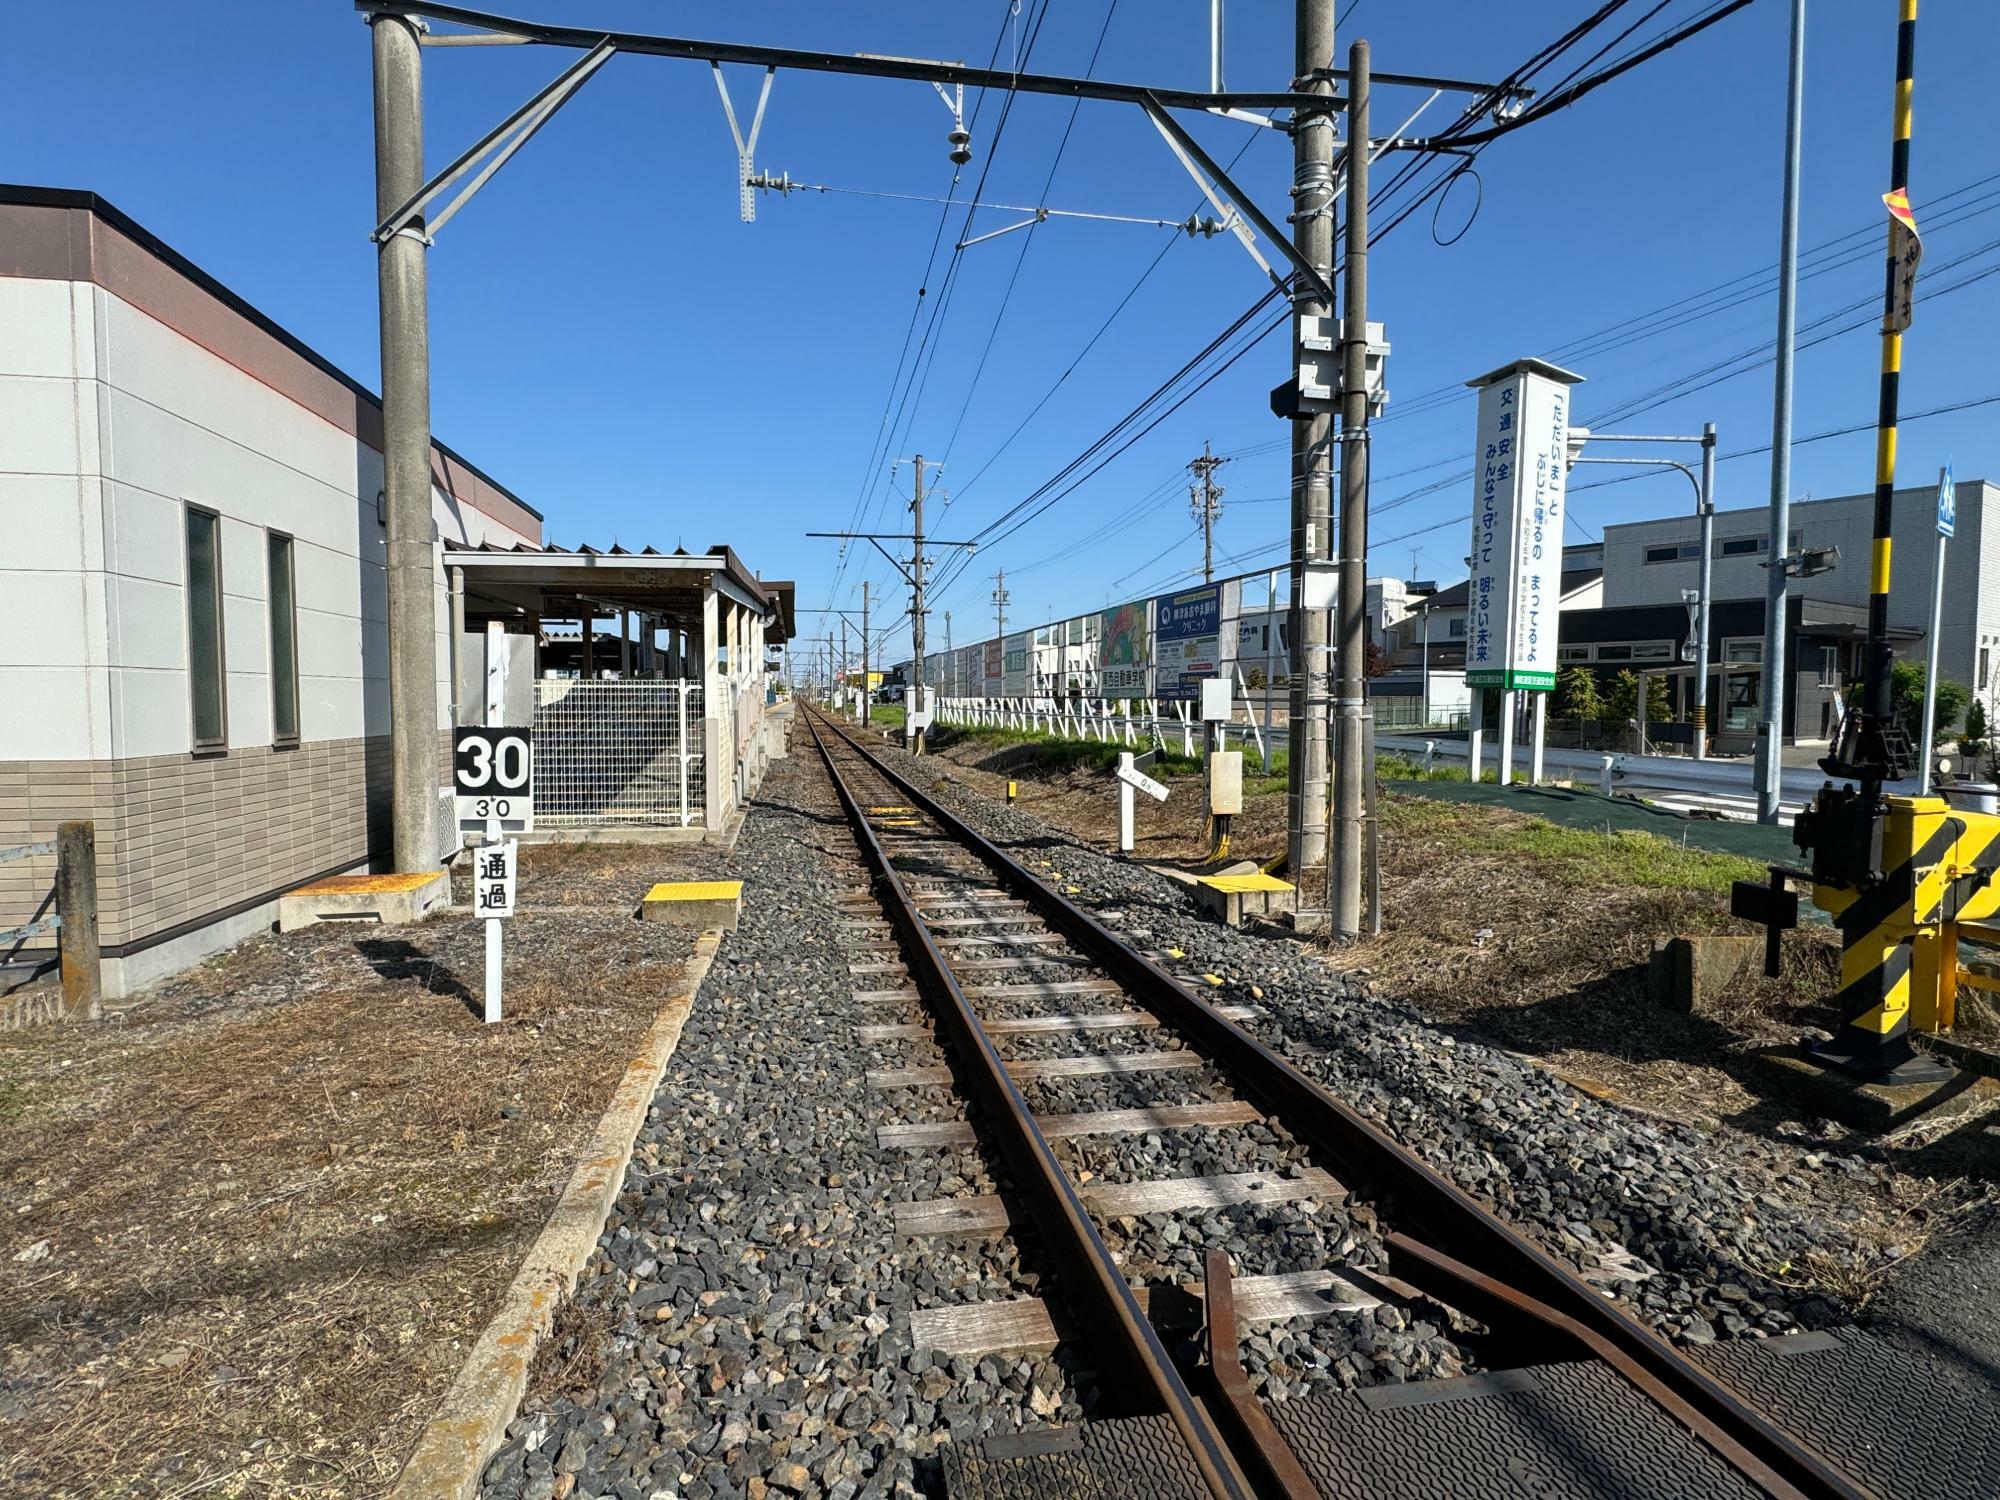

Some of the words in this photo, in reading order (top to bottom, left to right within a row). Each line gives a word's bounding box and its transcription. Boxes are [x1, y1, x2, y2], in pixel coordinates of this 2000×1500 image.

[1496, 387, 1513, 482] 交通安全
[1549, 393, 1565, 517] 「ただいま」と
[1481, 443, 1498, 564] みんなで守って
[1532, 452, 1548, 561] ぶじに帰るの
[1182, 618, 1207, 634] クリニック
[1476, 575, 1491, 663] 明るい未来
[1527, 574, 1541, 663] まってるよ
[457, 736, 530, 788] 30
[475, 799, 511, 818] 30
[480, 853, 508, 909] 通過
